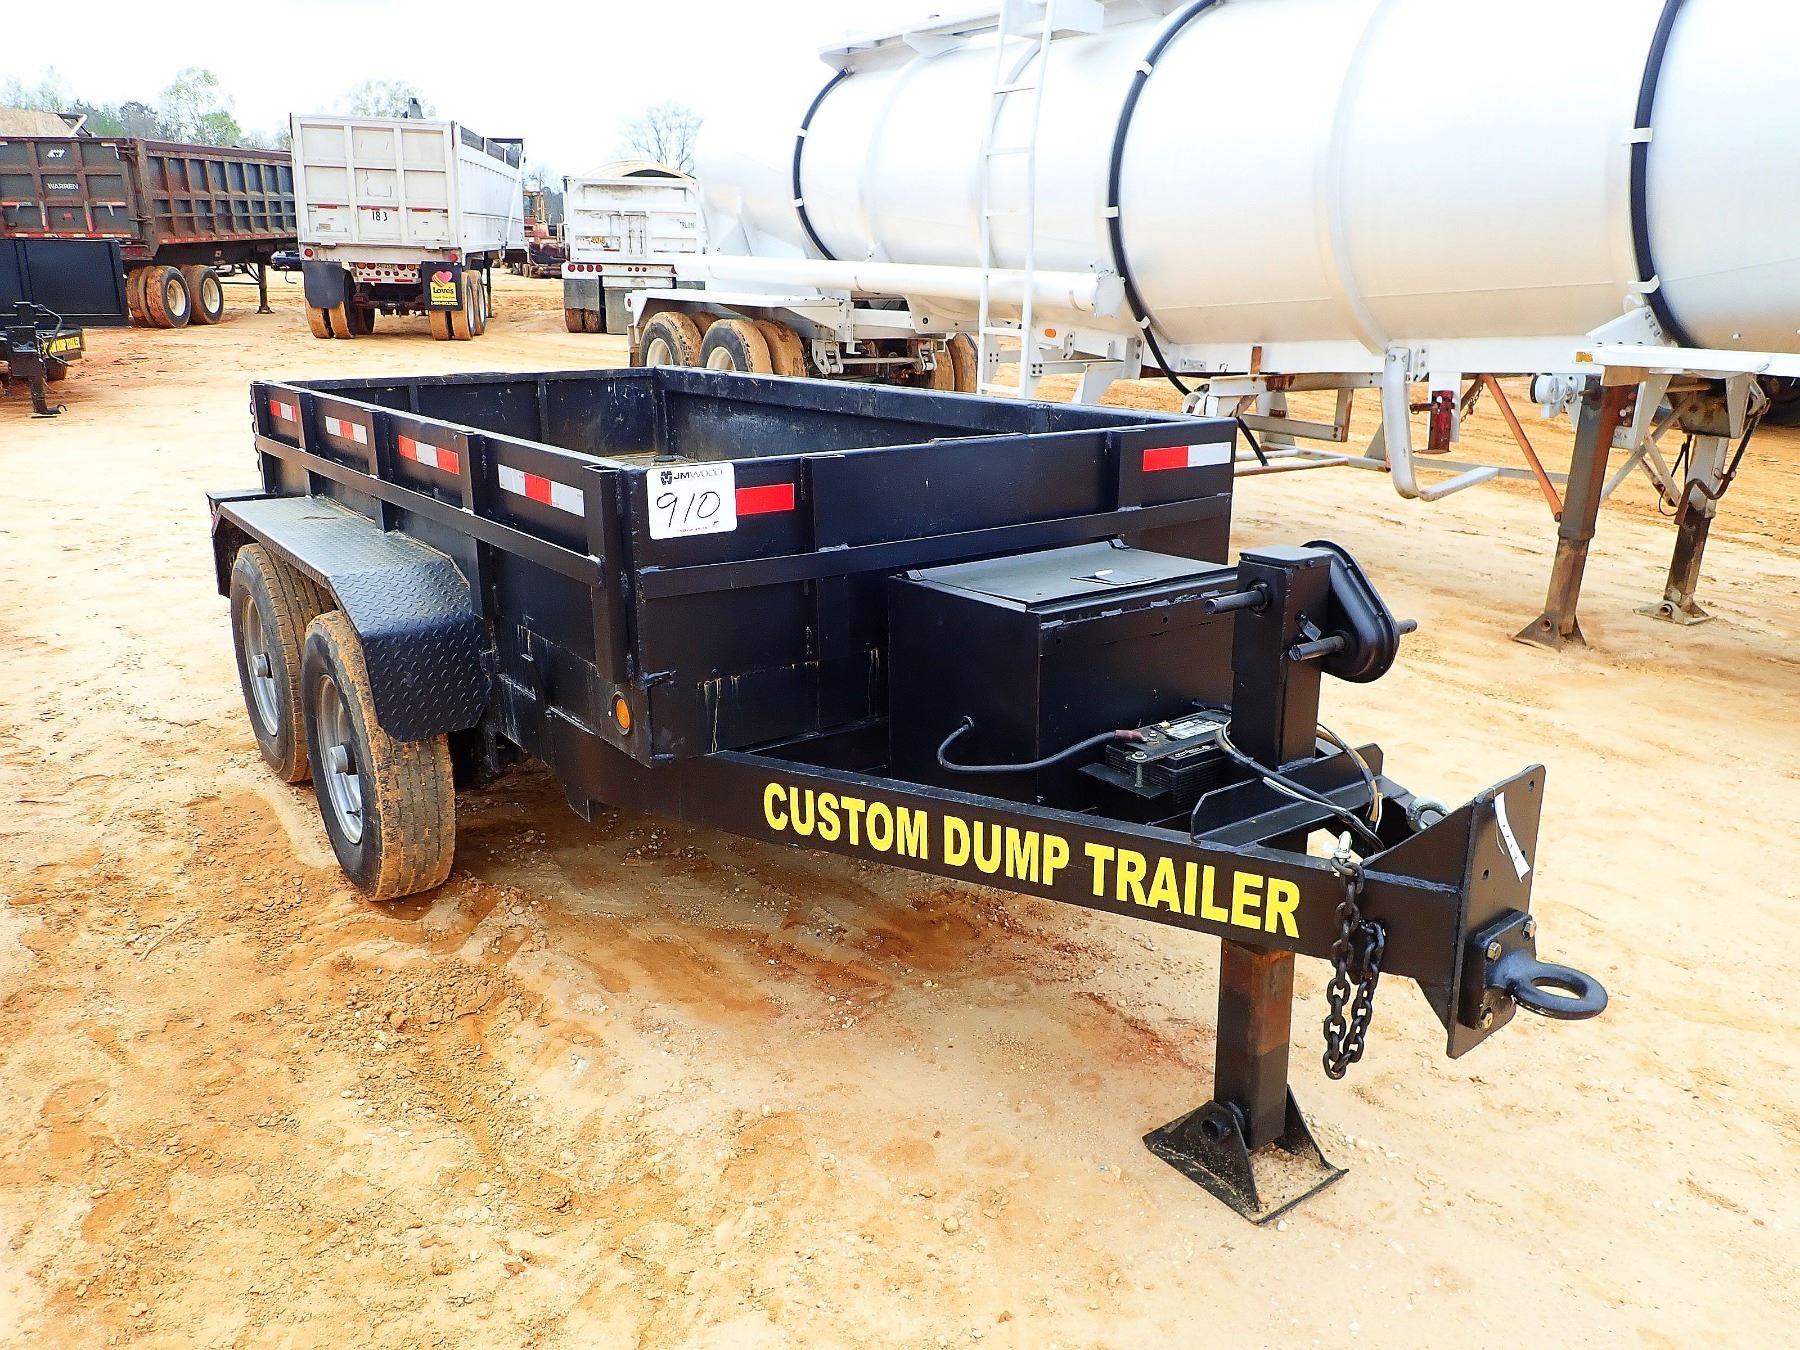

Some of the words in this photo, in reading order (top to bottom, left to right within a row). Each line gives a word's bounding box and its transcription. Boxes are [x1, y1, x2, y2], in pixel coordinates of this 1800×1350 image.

[433, 286, 455, 294] Love's
[656, 491, 721, 528] 910
[764, 782, 929, 860] CUSTOM
[944, 815, 1070, 886] DUMP
[1084, 842, 1300, 938] TRAILER
